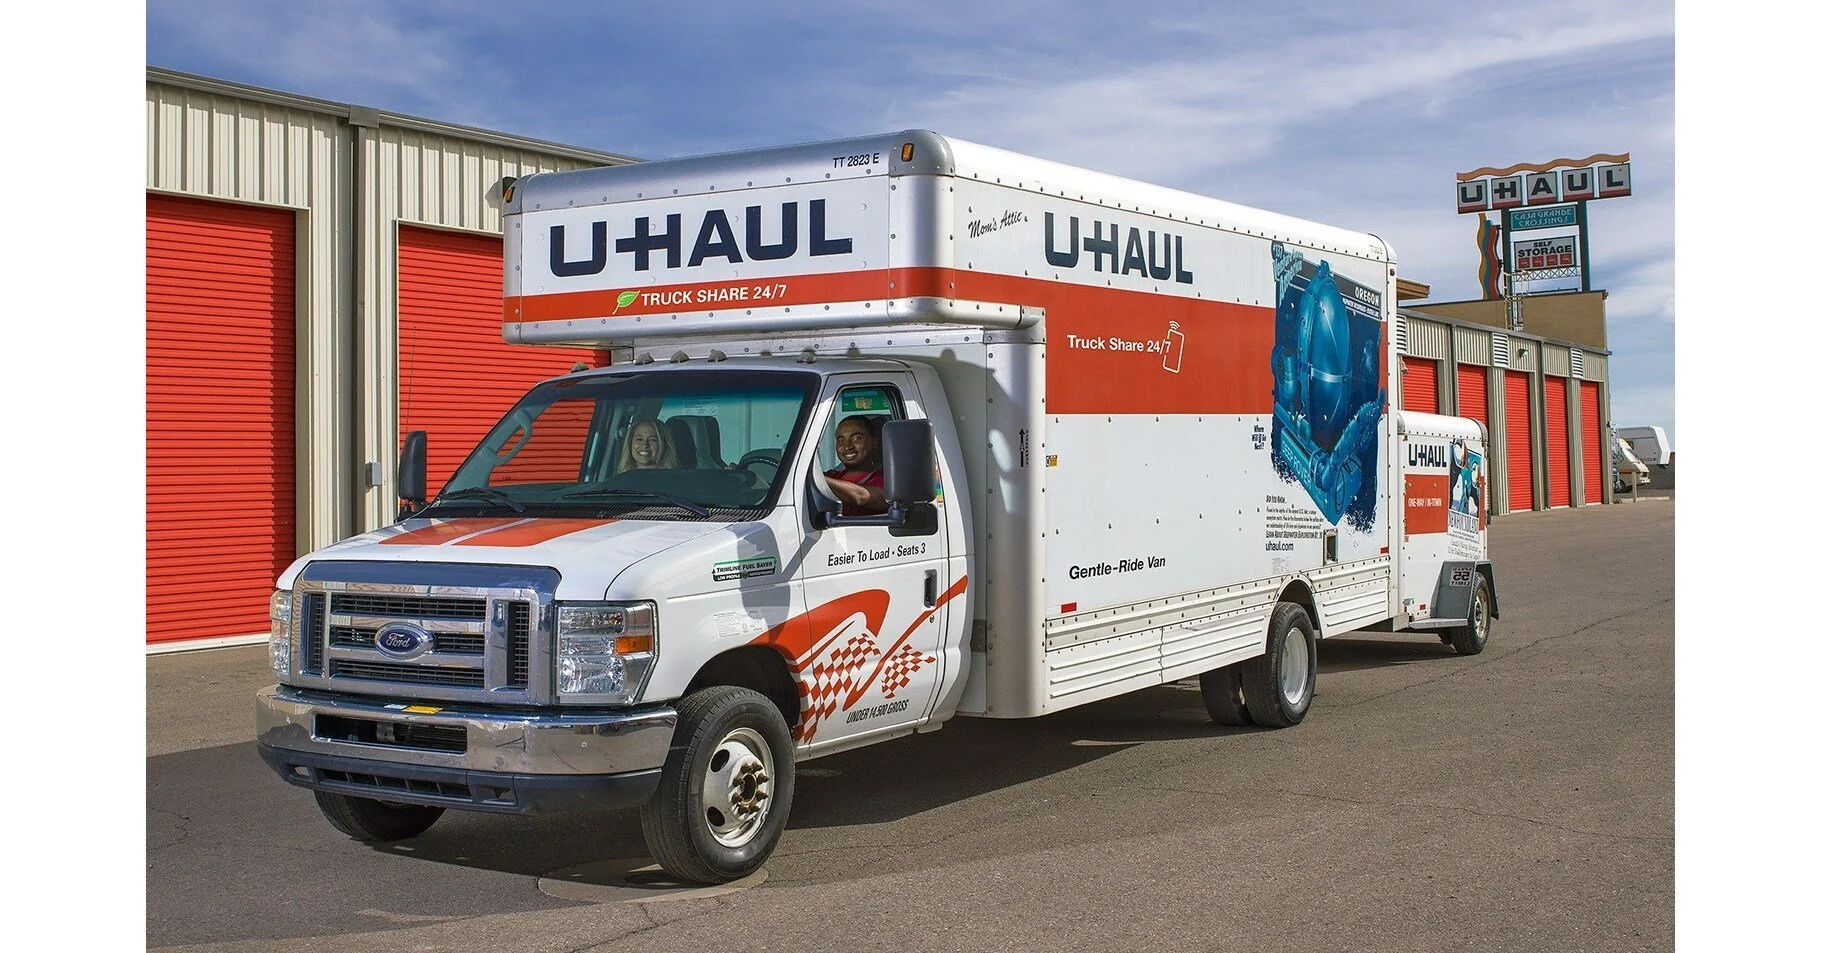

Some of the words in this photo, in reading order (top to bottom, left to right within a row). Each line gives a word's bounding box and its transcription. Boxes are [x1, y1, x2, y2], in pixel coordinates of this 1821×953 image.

[833, 156, 845, 168] TT
[847, 154, 870, 167] 2823
[872, 153, 880, 164] E
[968, 217, 998, 239] Mom's
[1000, 210, 1023, 229] Attic
[1514, 212, 1536, 221] CASA
[1537, 208, 1572, 218] GRANDE
[1519, 216, 1568, 227] CROSSINGS
[550, 199, 852, 277] U-HAUL
[1044, 212, 1193, 285] U-HAUL
[1518, 245, 1572, 257] STORAGE
[641, 290, 693, 306] TRUCK
[696, 287, 748, 303] SHARE
[753, 284, 788, 300] 24/7
[1354, 286, 1380, 308] OREGON
[1066, 334, 1105, 350] Truck
[1109, 337, 1144, 352] Share
[1147, 338, 1171, 355] 24/7
[1408, 443, 1447, 468] U-HAUL
[827, 553, 855, 566] Easier
[857, 550, 867, 562] To
[869, 547, 890, 560] Load
[897, 545, 919, 557] Seats
[920, 542, 926, 554] 3
[1266, 541, 1294, 551] uhaul.com
[756, 561, 773, 569] SAVER
[1069, 558, 1144, 580] Gentle-Ride
[1147, 556, 1166, 569] Van
[385, 632, 411, 648] Ford
[846, 707, 870, 724] UNDER
[869, 704, 888, 719] 14,500
[887, 699, 909, 714] GROSS
